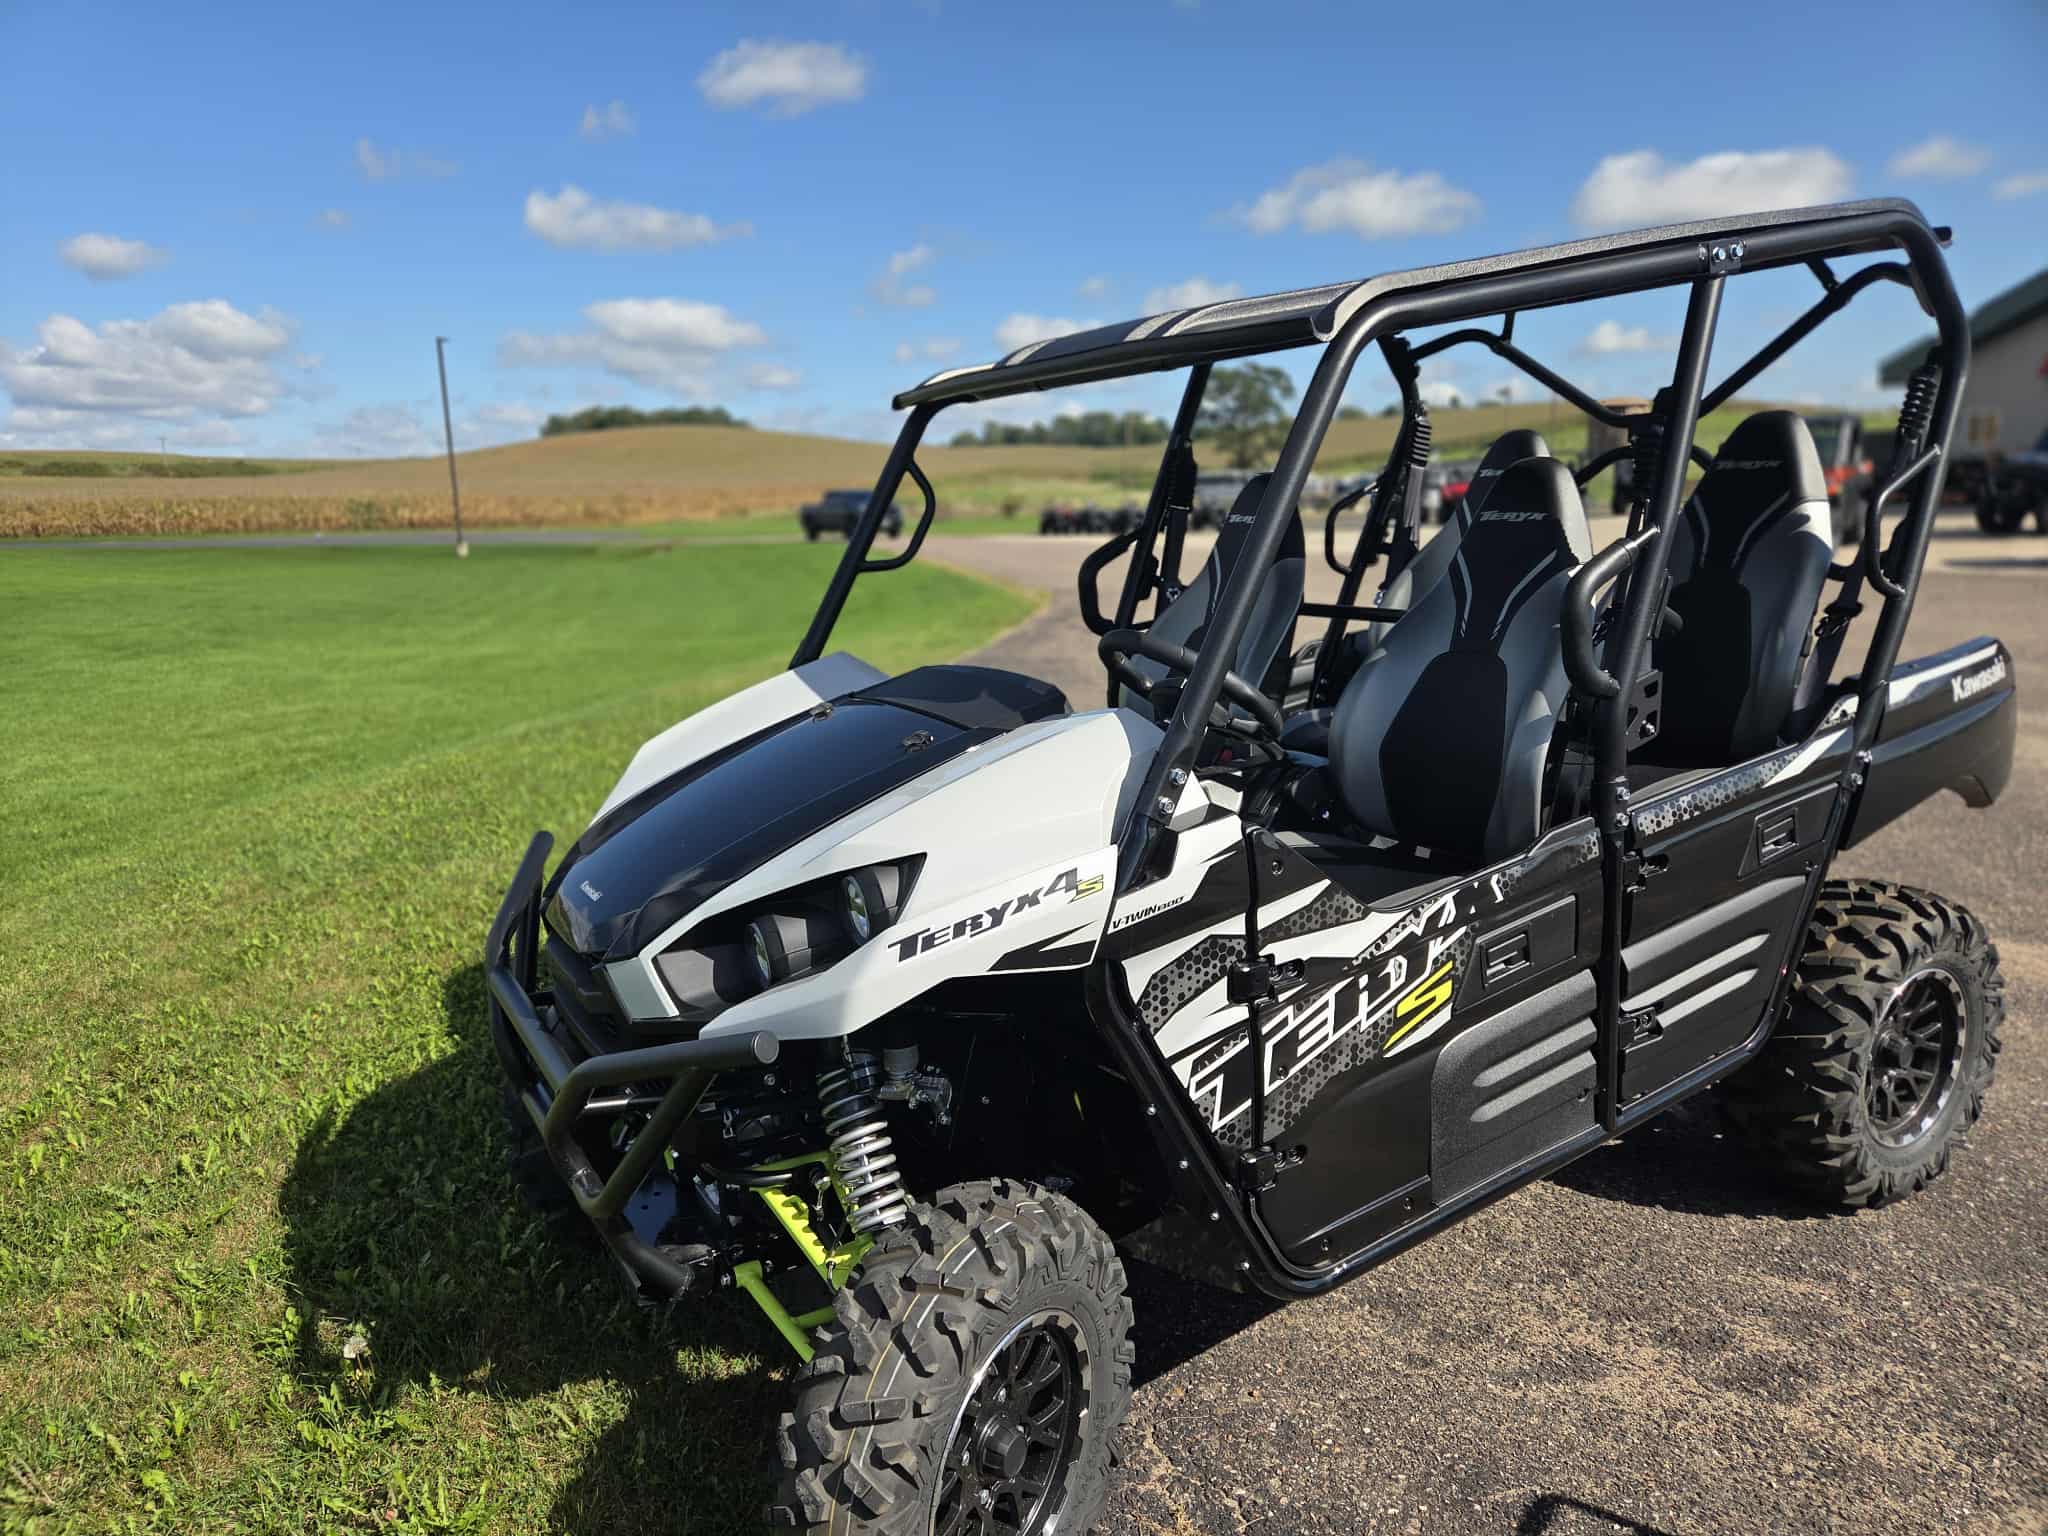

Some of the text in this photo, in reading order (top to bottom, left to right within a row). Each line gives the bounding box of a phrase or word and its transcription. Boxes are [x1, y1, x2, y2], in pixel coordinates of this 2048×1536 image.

[1479, 510, 1550, 522] TERYX
[1951, 655, 2006, 703] Kawasaki
[1383, 960, 1453, 1050] S
